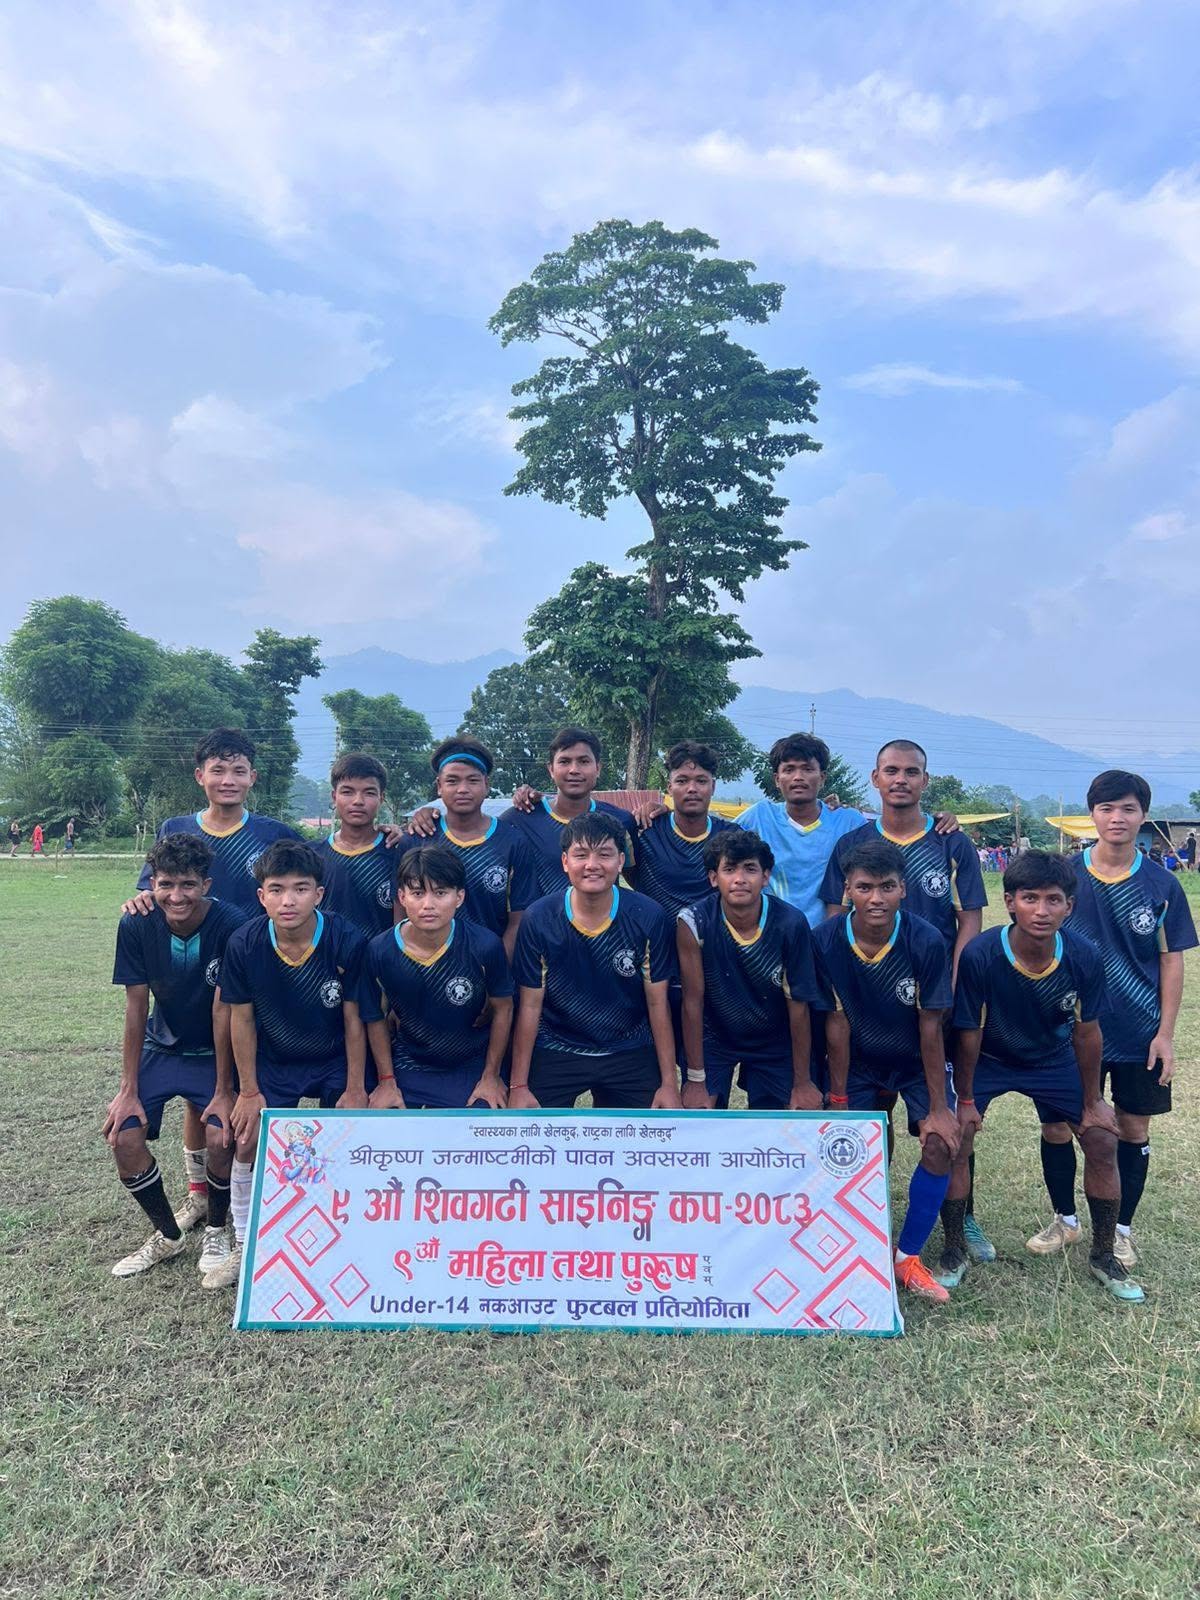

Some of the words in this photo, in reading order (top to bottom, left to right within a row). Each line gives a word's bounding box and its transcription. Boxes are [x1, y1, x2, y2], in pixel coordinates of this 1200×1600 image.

[519, 1123, 541, 1138] लागि
[582, 1126, 613, 1141] राष्ट्रका
[615, 1124, 637, 1139] लागि
[349, 1144, 424, 1172] श्रीकृष्ण
[432, 1145, 557, 1166] जन्माष्टमीको
[565, 1149, 615, 1166] पावन
[623, 1150, 711, 1168] अवसरमा
[718, 1147, 806, 1169] आयोजित
[414, 1176, 530, 1224] शिवगढी
[448, 1240, 548, 1287] महिला
[552, 1250, 616, 1282] तथा
[370, 1295, 470, 1314] Under-14
[479, 1298, 557, 1315] नकआउट
[566, 1299, 638, 1320] फुटबल
[645, 1295, 751, 1319] प्रतियोगिता
